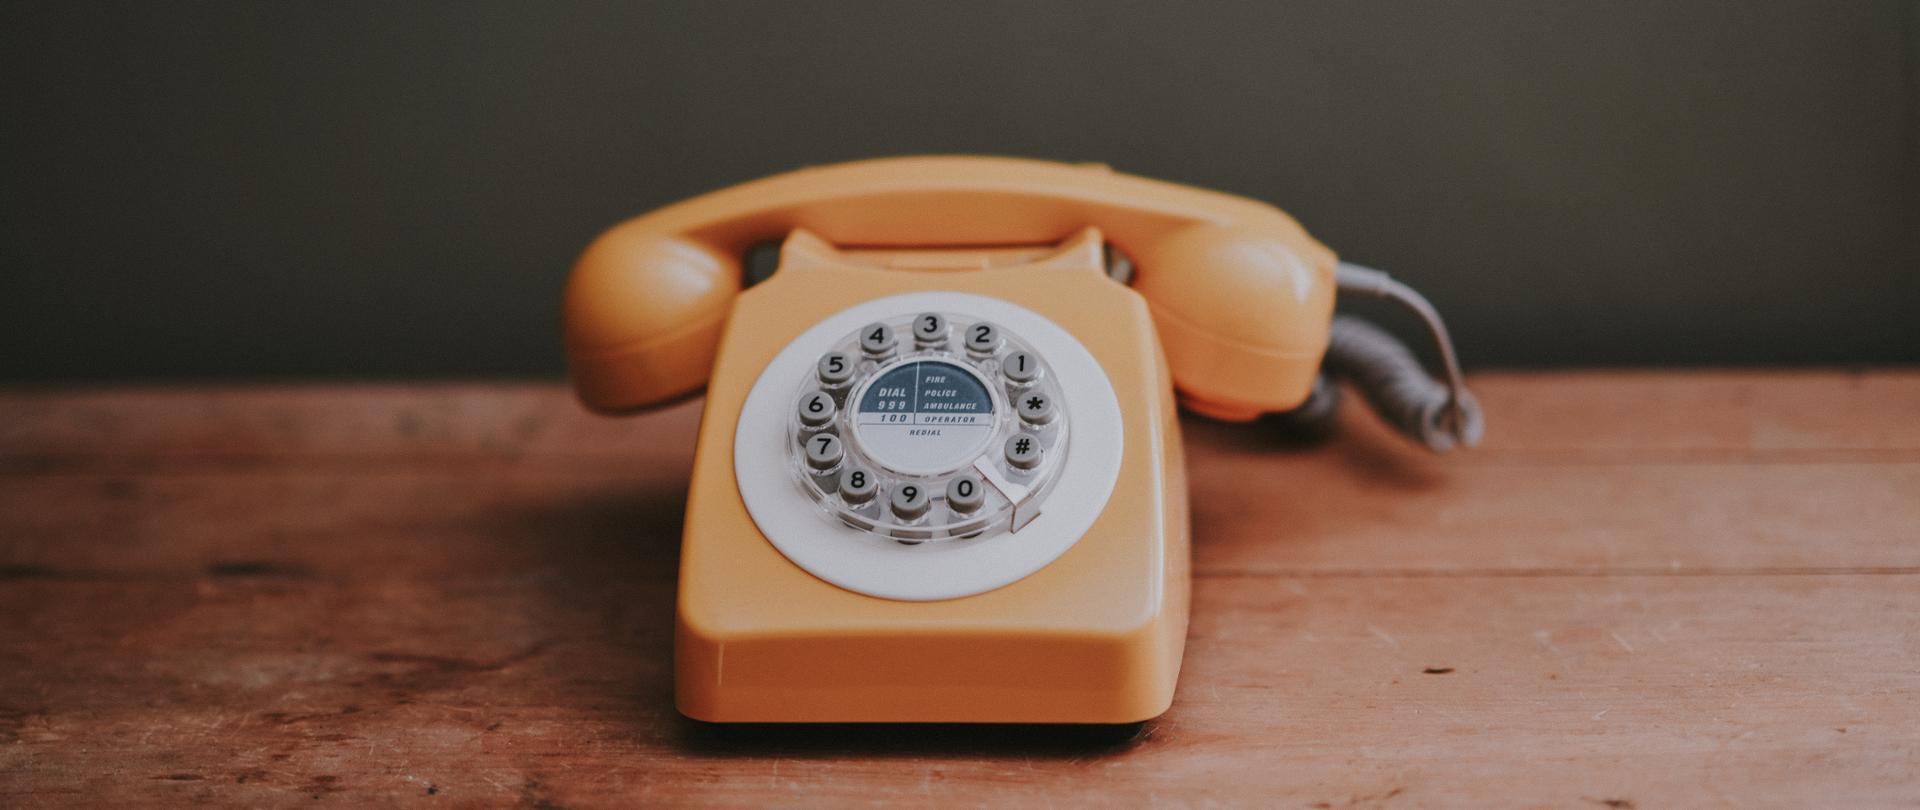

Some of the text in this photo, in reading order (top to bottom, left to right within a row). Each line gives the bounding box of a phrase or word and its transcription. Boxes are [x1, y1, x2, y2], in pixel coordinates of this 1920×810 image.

[924, 316, 937, 333] 3
[869, 327, 885, 343] 4
[976, 326, 990, 343] 2
[829, 357, 843, 373] 5
[1017, 355, 1025, 372] 1
[925, 376, 946, 384] FIRE
[879, 388, 906, 397] DIAL
[809, 396, 823, 412] 6
[923, 402, 977, 410] AMBULANCE
[817, 438, 831, 455] 7
[1016, 439, 1030, 454] #
[851, 471, 865, 488] 8
[902, 486, 917, 502] 9
[958, 480, 973, 497] 0
